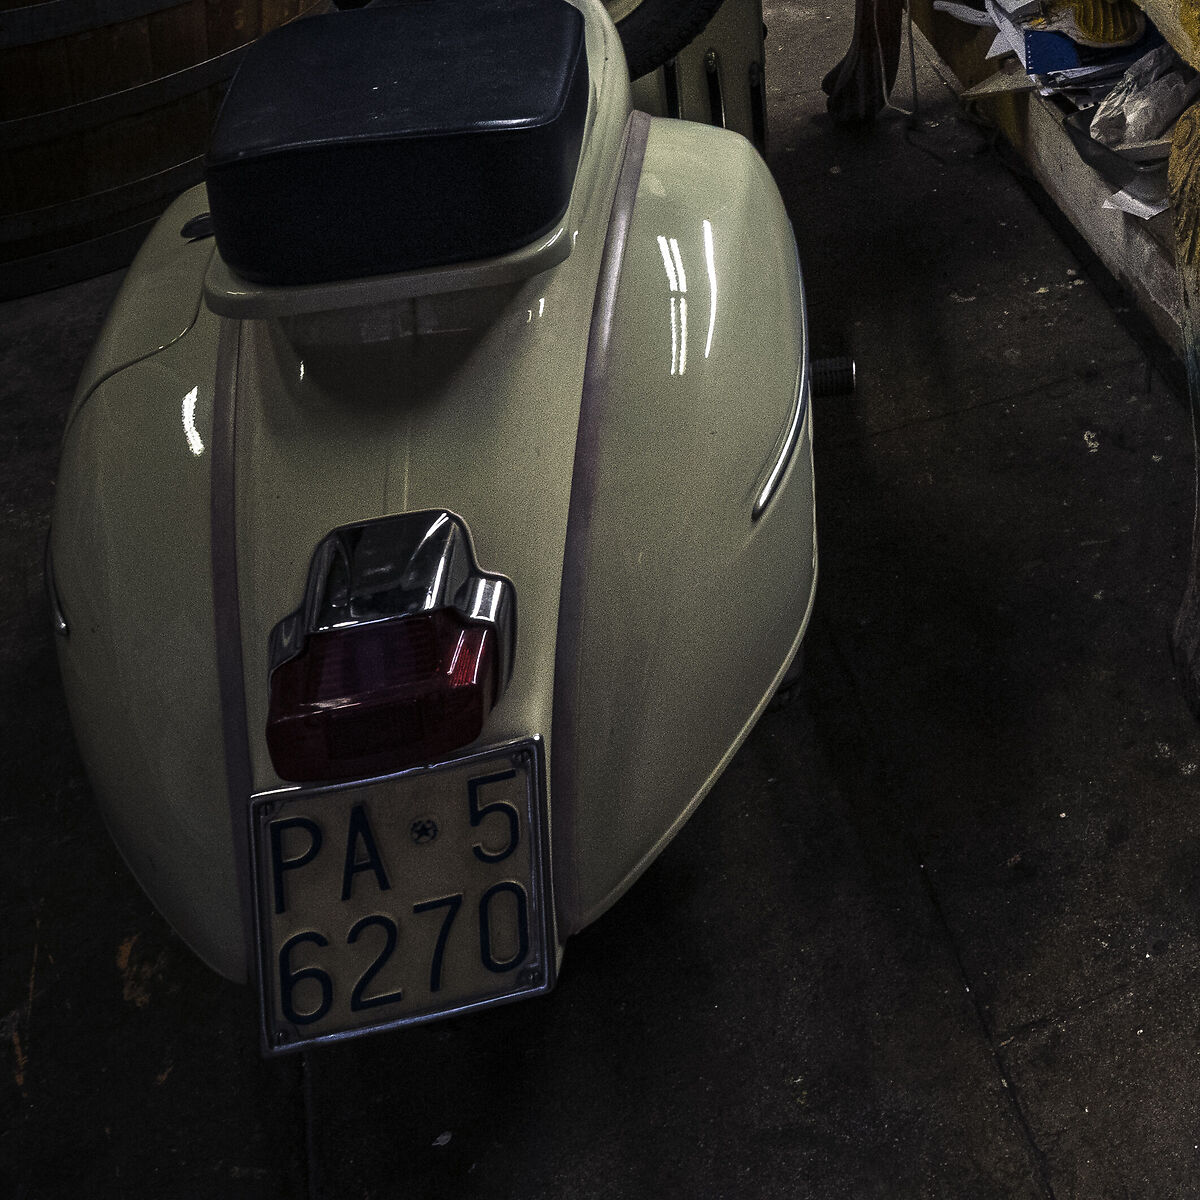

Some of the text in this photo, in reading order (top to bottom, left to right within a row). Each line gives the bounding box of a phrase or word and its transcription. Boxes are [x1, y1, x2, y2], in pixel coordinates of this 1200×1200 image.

[269, 767, 521, 915] PA 5
[277, 881, 530, 1026] 6270
